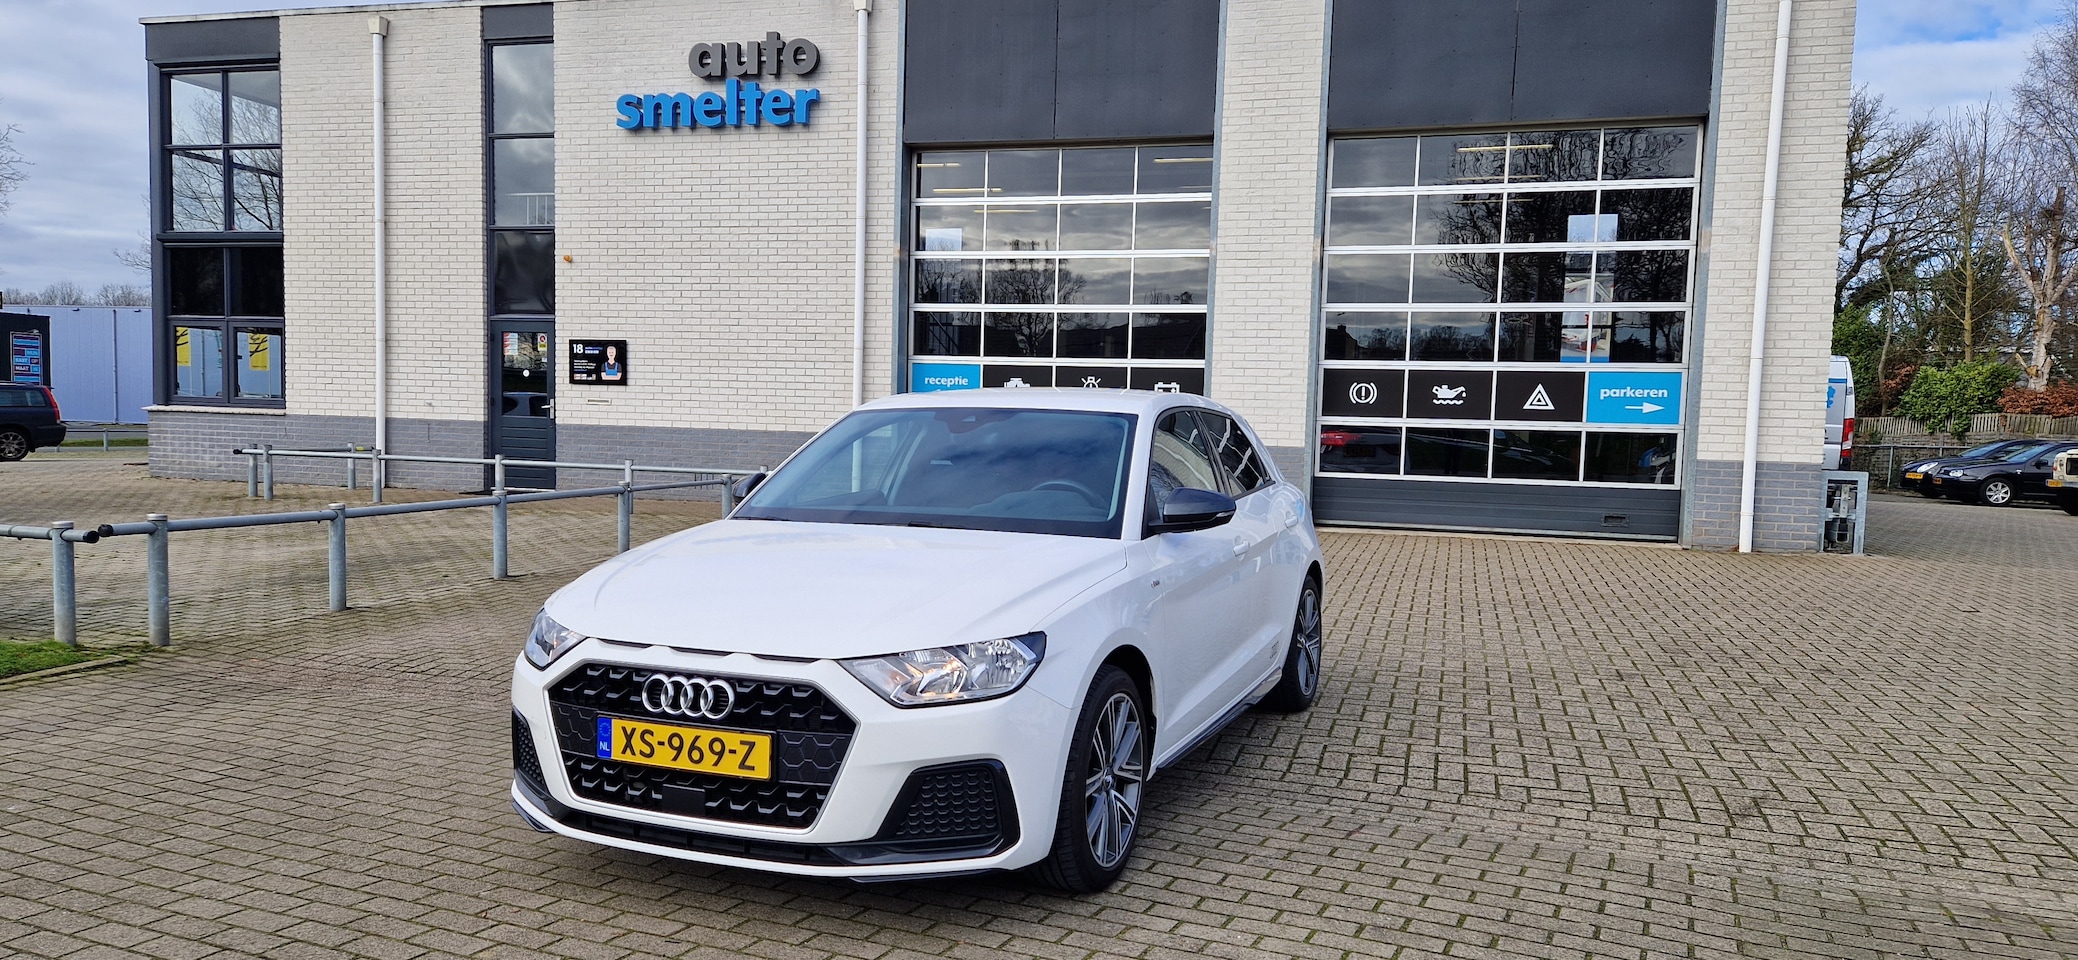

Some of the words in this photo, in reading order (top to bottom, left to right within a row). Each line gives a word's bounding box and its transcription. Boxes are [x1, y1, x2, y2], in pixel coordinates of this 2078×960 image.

[688, 31, 820, 78] auto
[616, 78, 820, 129] smelter
[572, 343, 584, 354] 18
[924, 376, 969, 388] receptie
[1600, 386, 1668, 400] parkeren
[599, 741, 610, 752] NL
[620, 725, 756, 771] XS-969-Z
